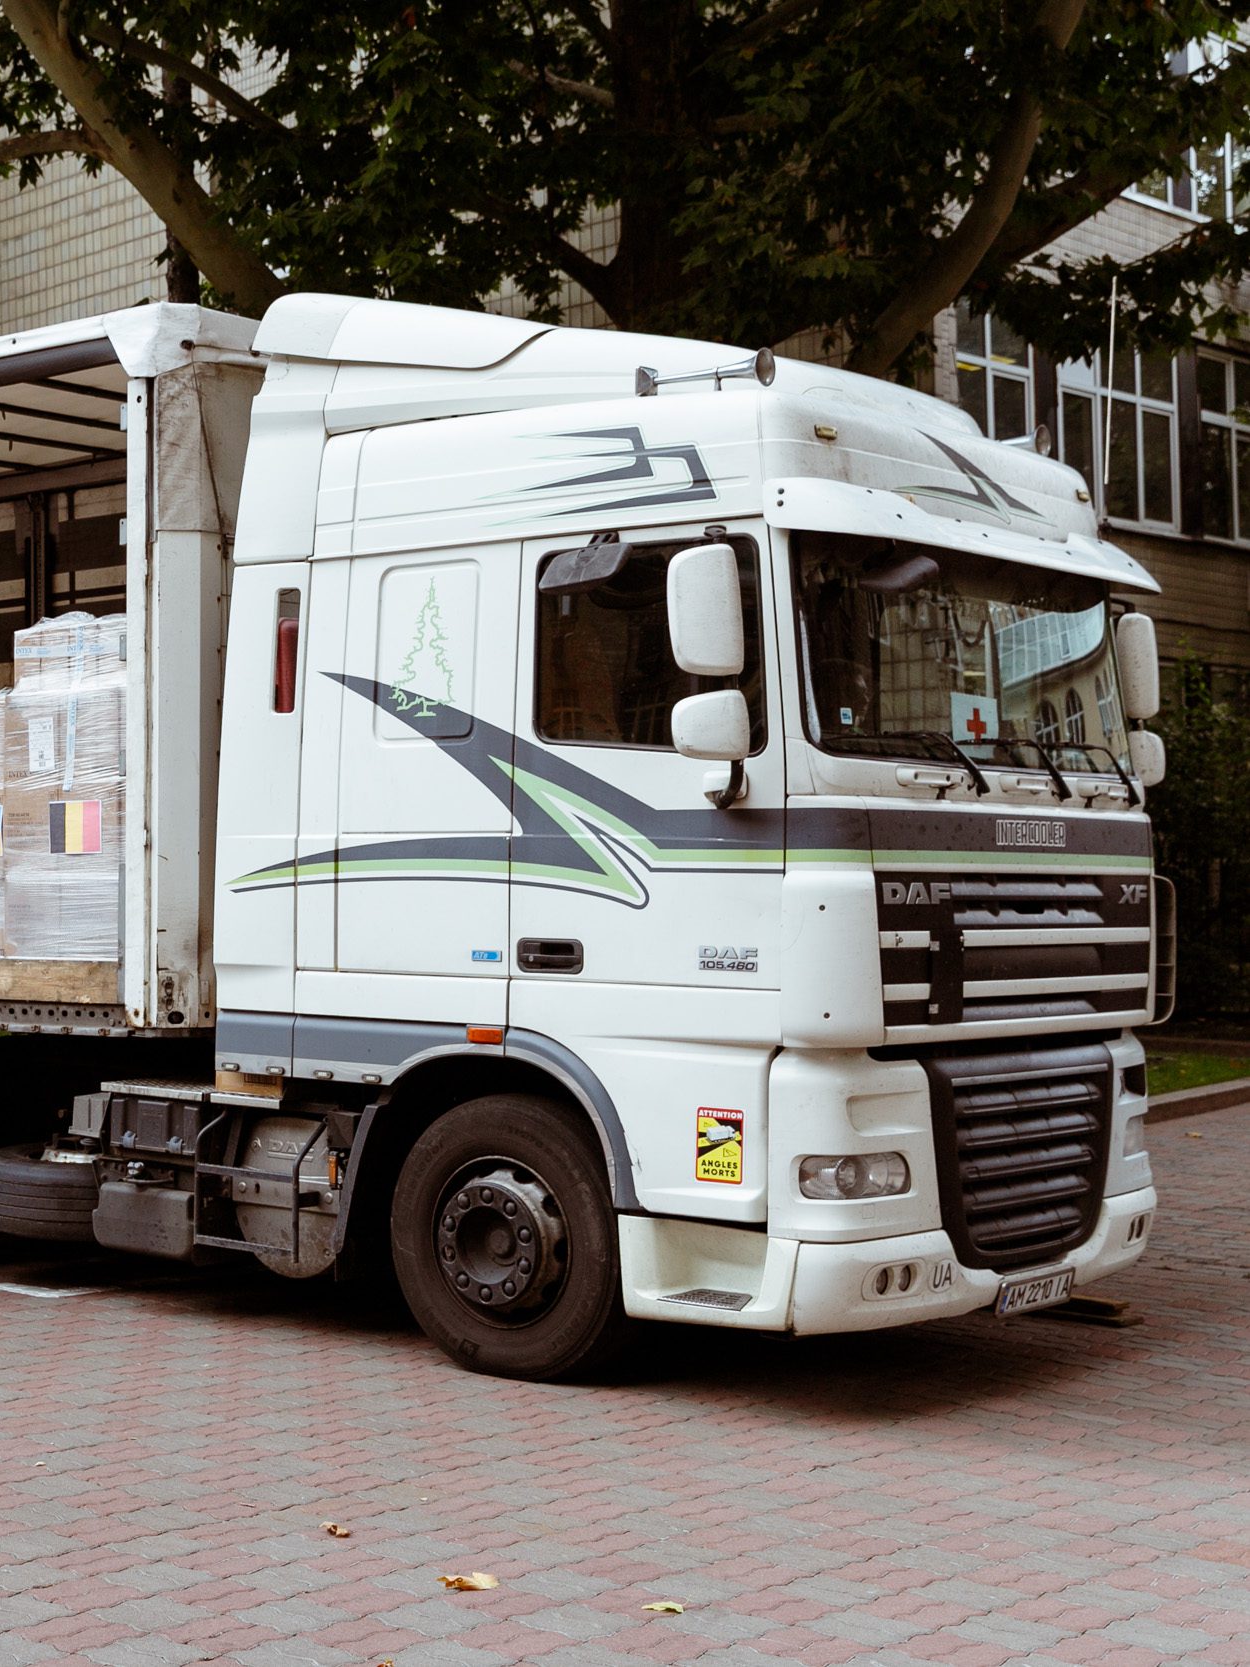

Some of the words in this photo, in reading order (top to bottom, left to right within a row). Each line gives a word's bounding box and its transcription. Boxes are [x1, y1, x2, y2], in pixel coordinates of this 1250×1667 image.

[996, 819, 1066, 847] INTERCOOLER
[881, 882, 951, 905] DAF
[1118, 884, 1148, 904] XF
[698, 945, 758, 959] DAF
[699, 960, 756, 971] 105.460
[698, 1109, 743, 1119] ATTENTION
[701, 1159, 738, 1170] ANGLES
[703, 1168, 736, 1178] MORTS
[932, 1262, 953, 1289] UA
[1005, 1285, 1027, 1310] AM
[1026, 1280, 1052, 1304] 2210
